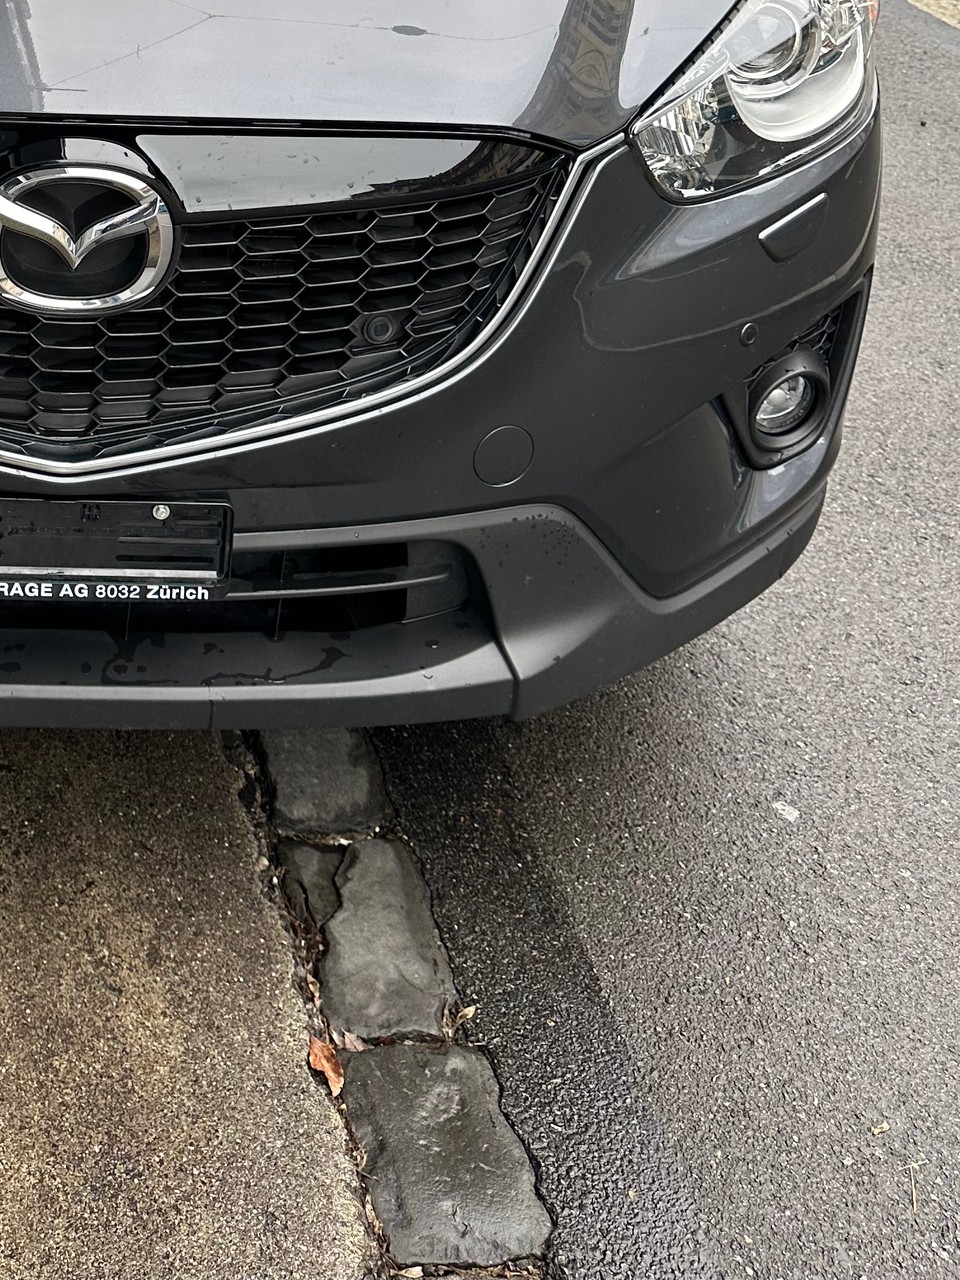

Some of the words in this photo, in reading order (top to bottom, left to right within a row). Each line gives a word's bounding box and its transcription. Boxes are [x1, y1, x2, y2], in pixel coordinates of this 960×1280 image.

[58, 583, 89, 598] AG
[95, 584, 140, 599] 8032
[145, 584, 209, 600] Zürich
